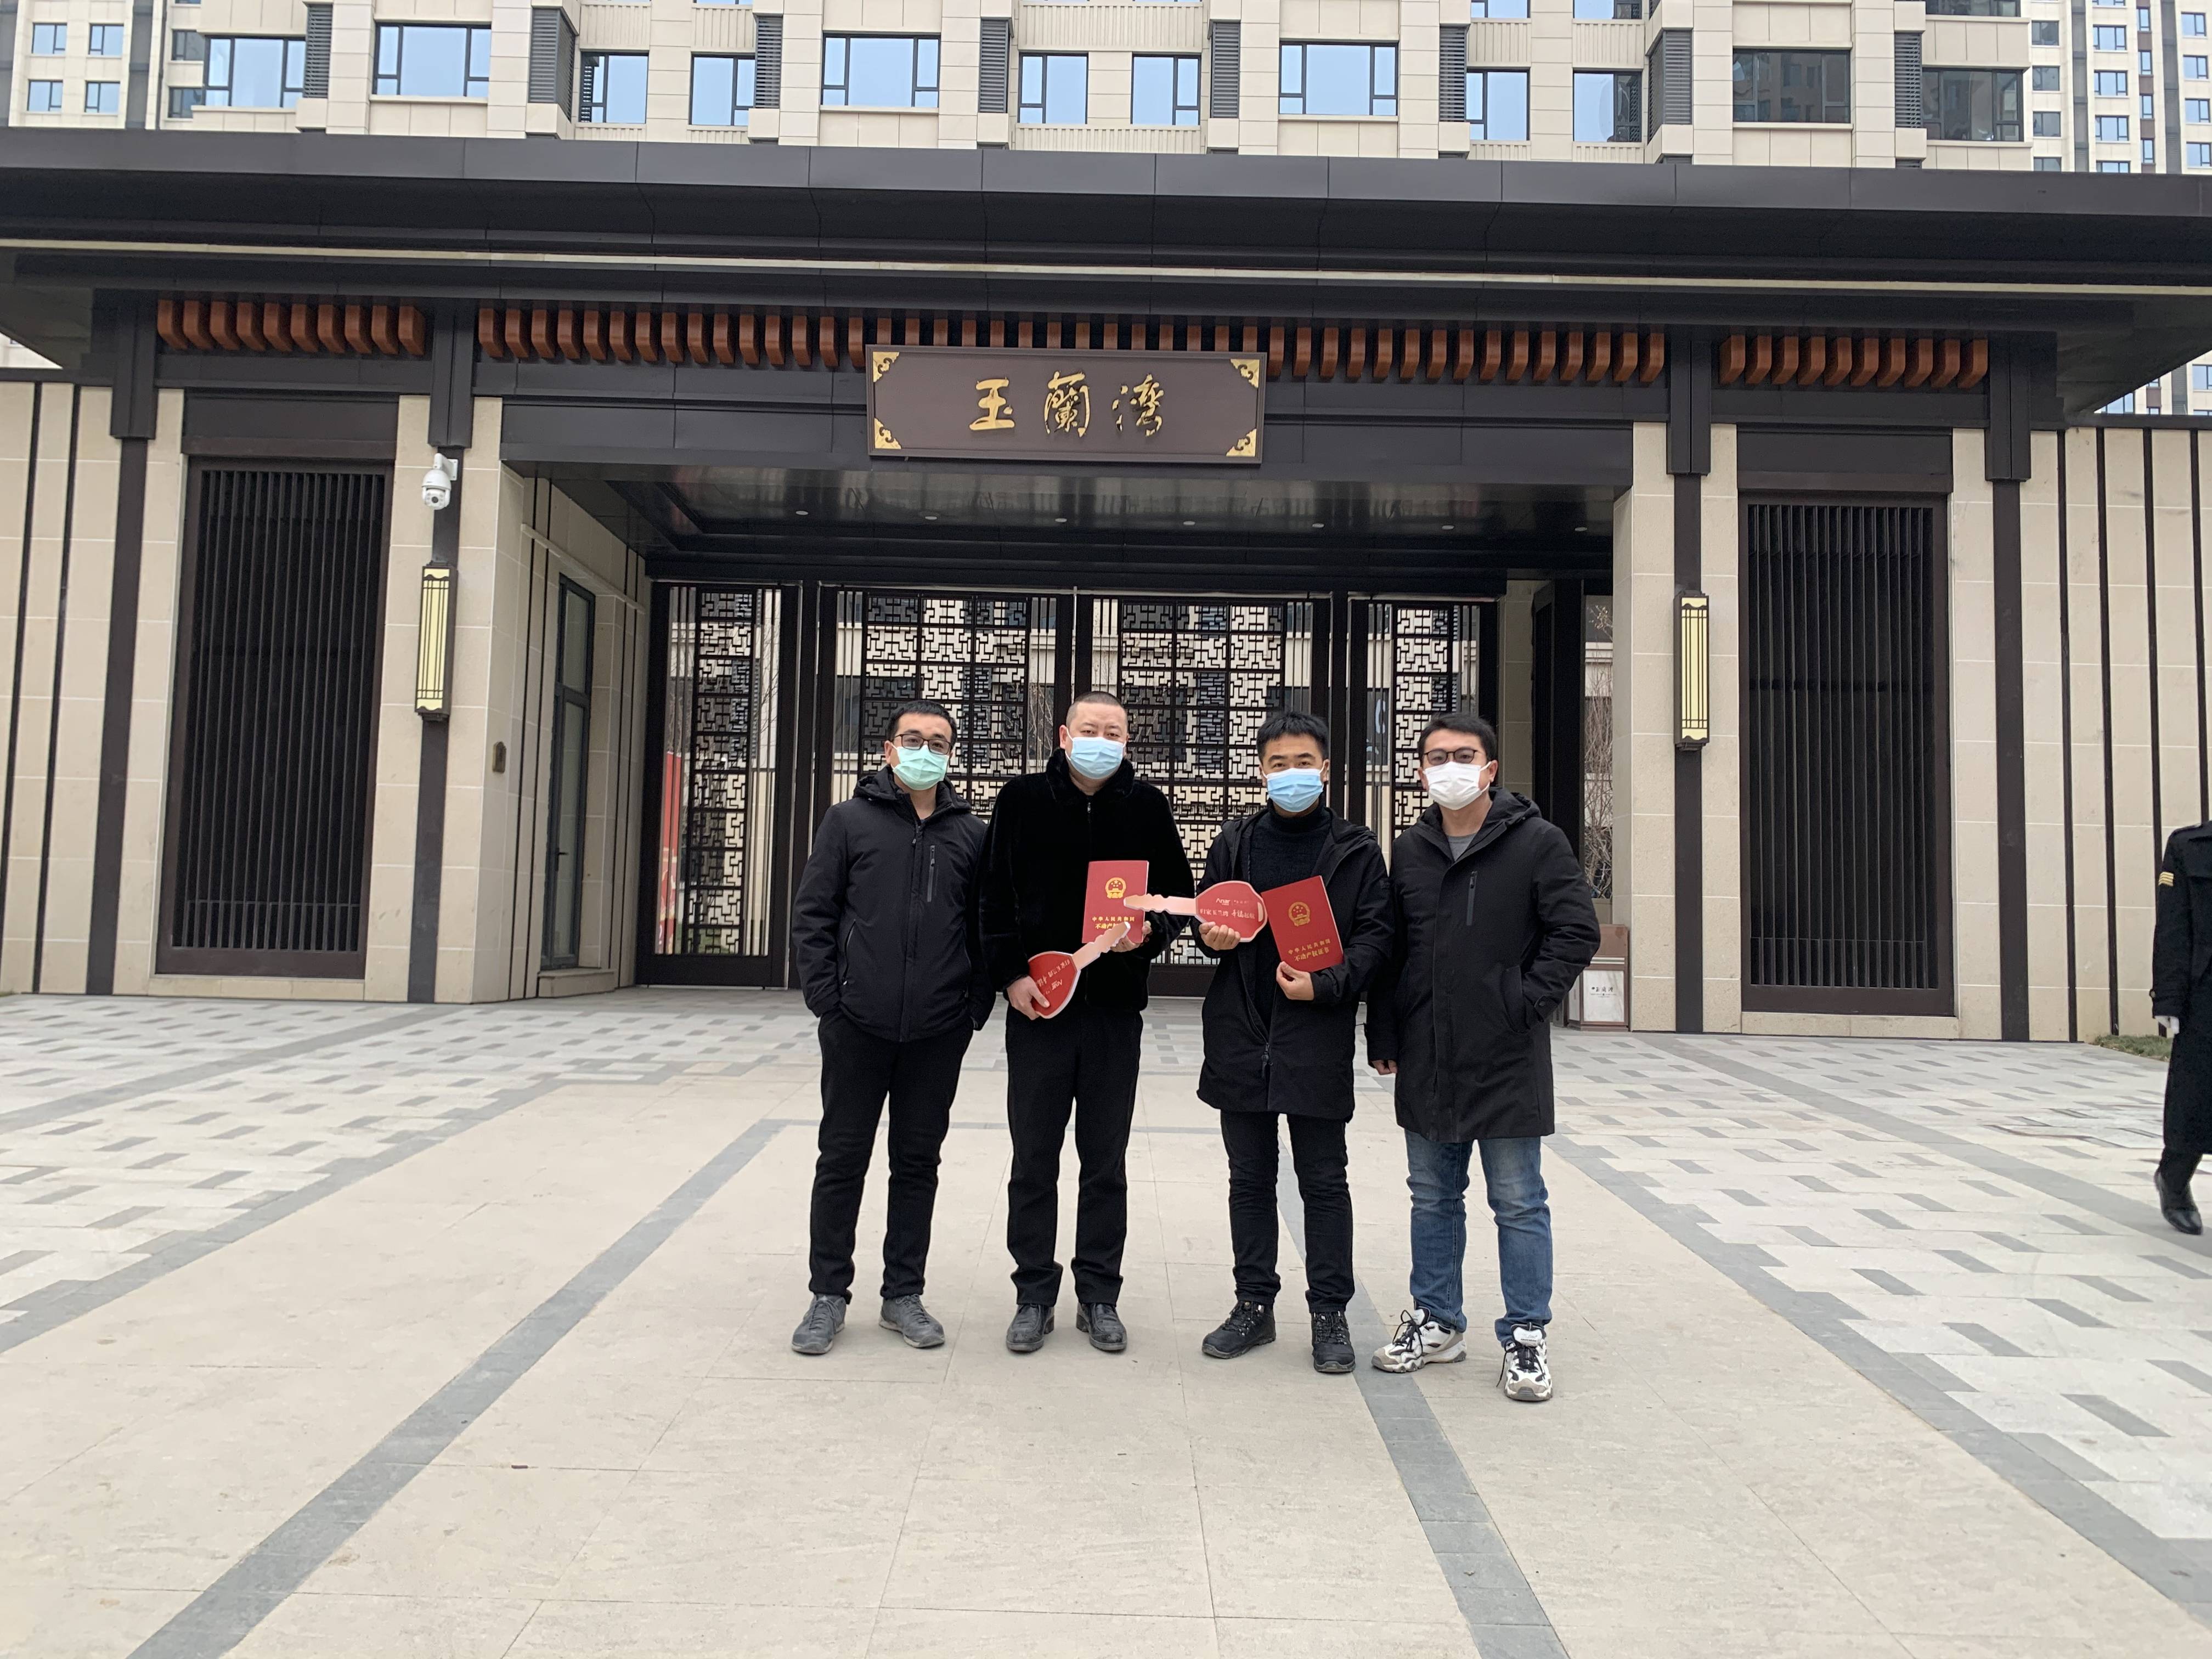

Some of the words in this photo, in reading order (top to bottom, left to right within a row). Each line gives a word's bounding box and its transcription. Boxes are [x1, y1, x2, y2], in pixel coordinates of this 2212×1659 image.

[1288, 938, 1330, 955] 中华人民共和国
[1295, 947, 1329, 962] 不动产权证书
